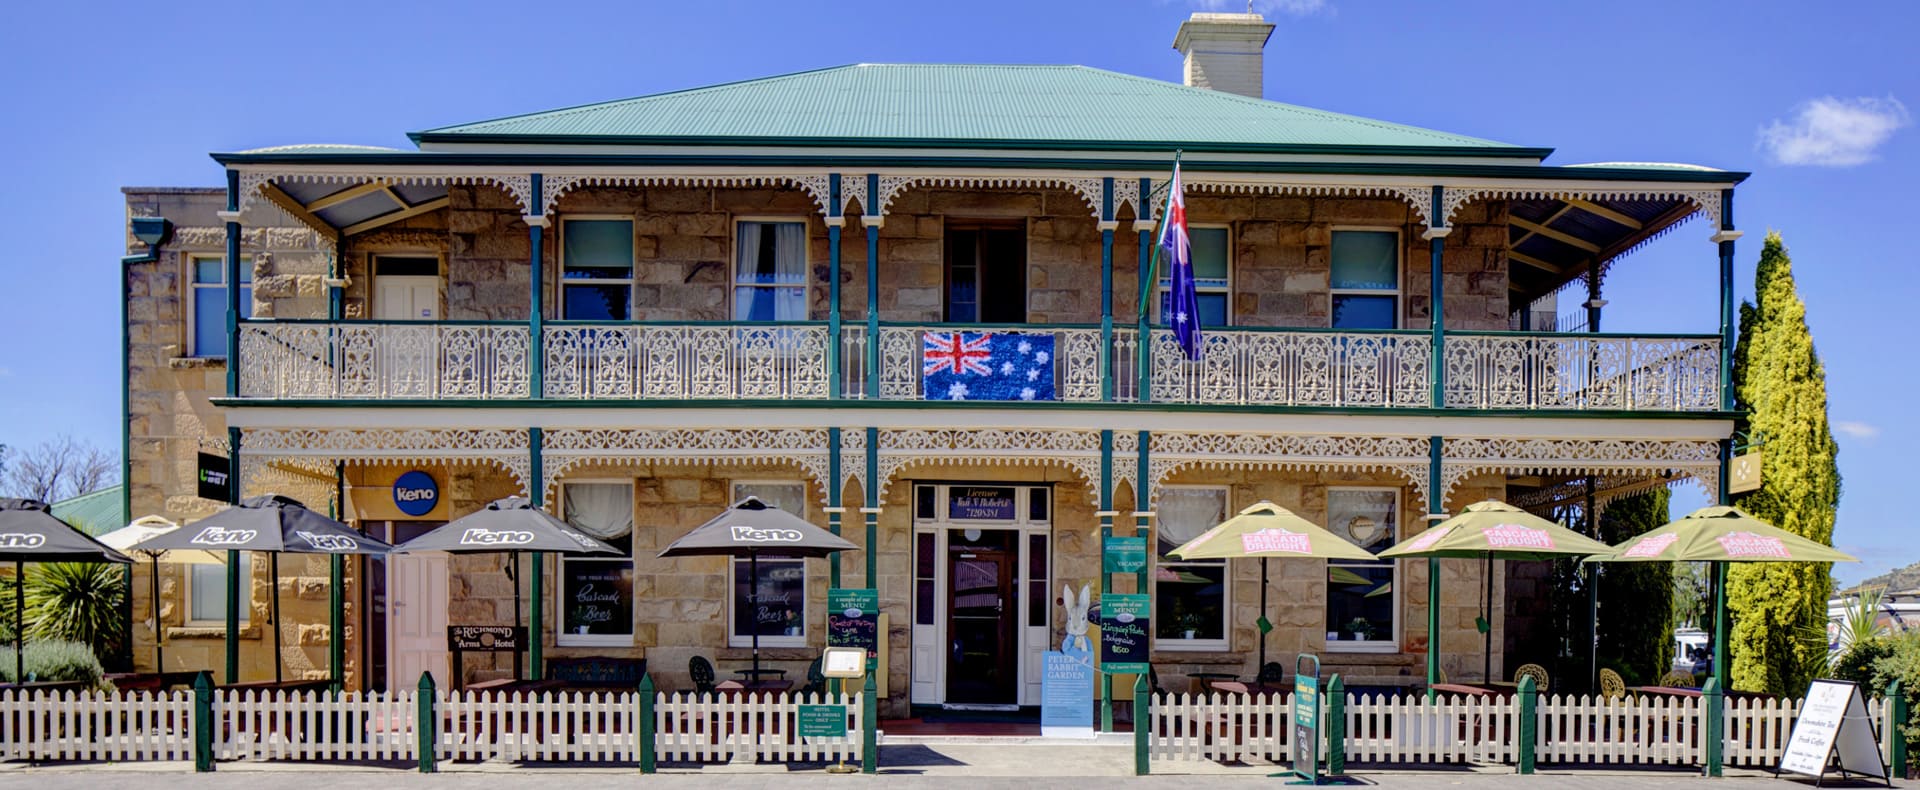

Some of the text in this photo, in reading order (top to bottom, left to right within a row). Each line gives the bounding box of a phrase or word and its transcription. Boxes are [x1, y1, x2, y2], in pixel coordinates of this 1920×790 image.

[1243, 534, 1308, 544] CASCADE
[1485, 529, 1547, 540] CASCADE
[1246, 541, 1309, 551] DRAUGHT
[1488, 536, 1550, 547] DRAUGHT
[1722, 538, 1780, 550] CASCADE
[1727, 545, 1785, 557] DRAUGHT
[576, 583, 620, 605] Cascade
[583, 605, 612, 622] Beer
[757, 606, 783, 623] Beer
[463, 627, 513, 639] RICHMOND
[459, 640, 515, 648] Arms Hotel
[1048, 655, 1075, 663] PETER
[1048, 663, 1079, 671] RABBIT
[1047, 671, 1085, 679] GARDEN
